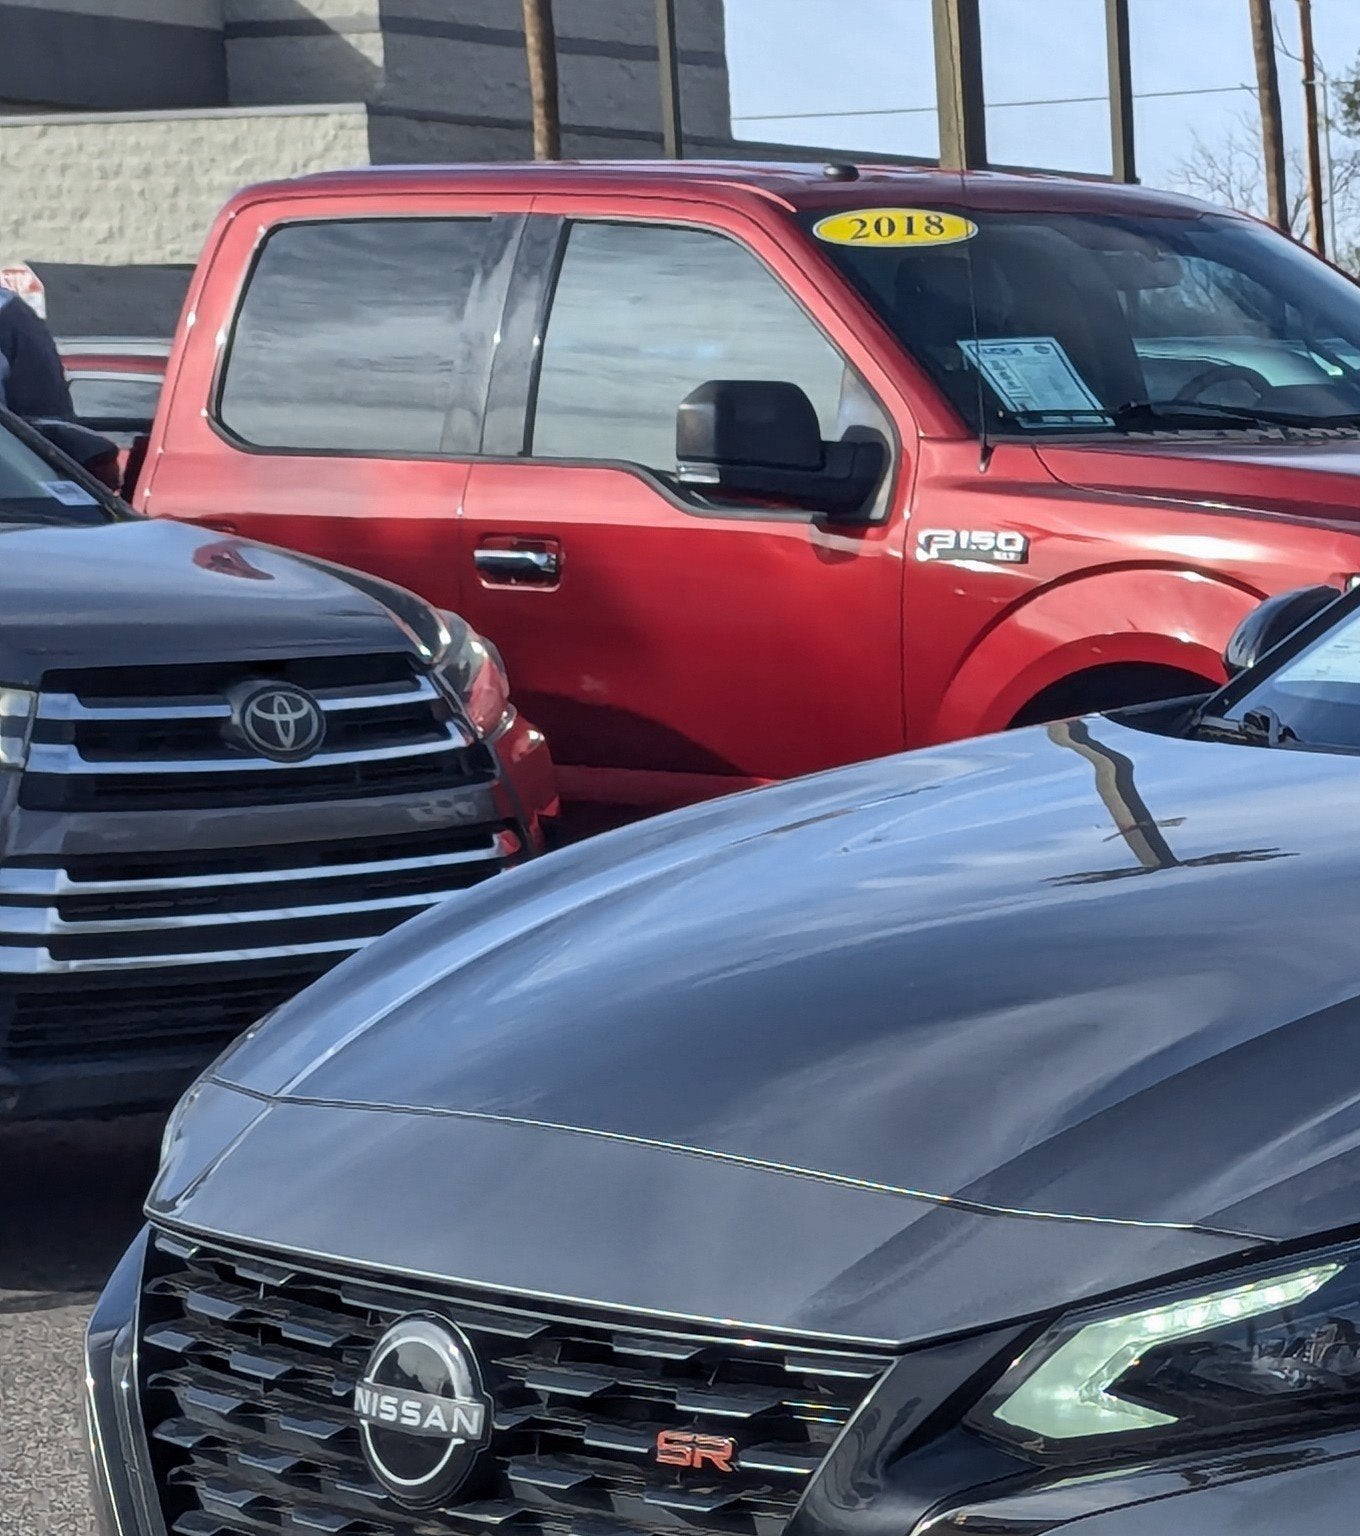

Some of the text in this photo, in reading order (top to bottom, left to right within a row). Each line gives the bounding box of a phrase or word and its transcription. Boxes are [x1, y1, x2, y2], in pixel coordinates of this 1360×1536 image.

[848, 215, 945, 240] 2018
[354, 1385, 480, 1435] NISSAN
[656, 1430, 733, 1472] SR
